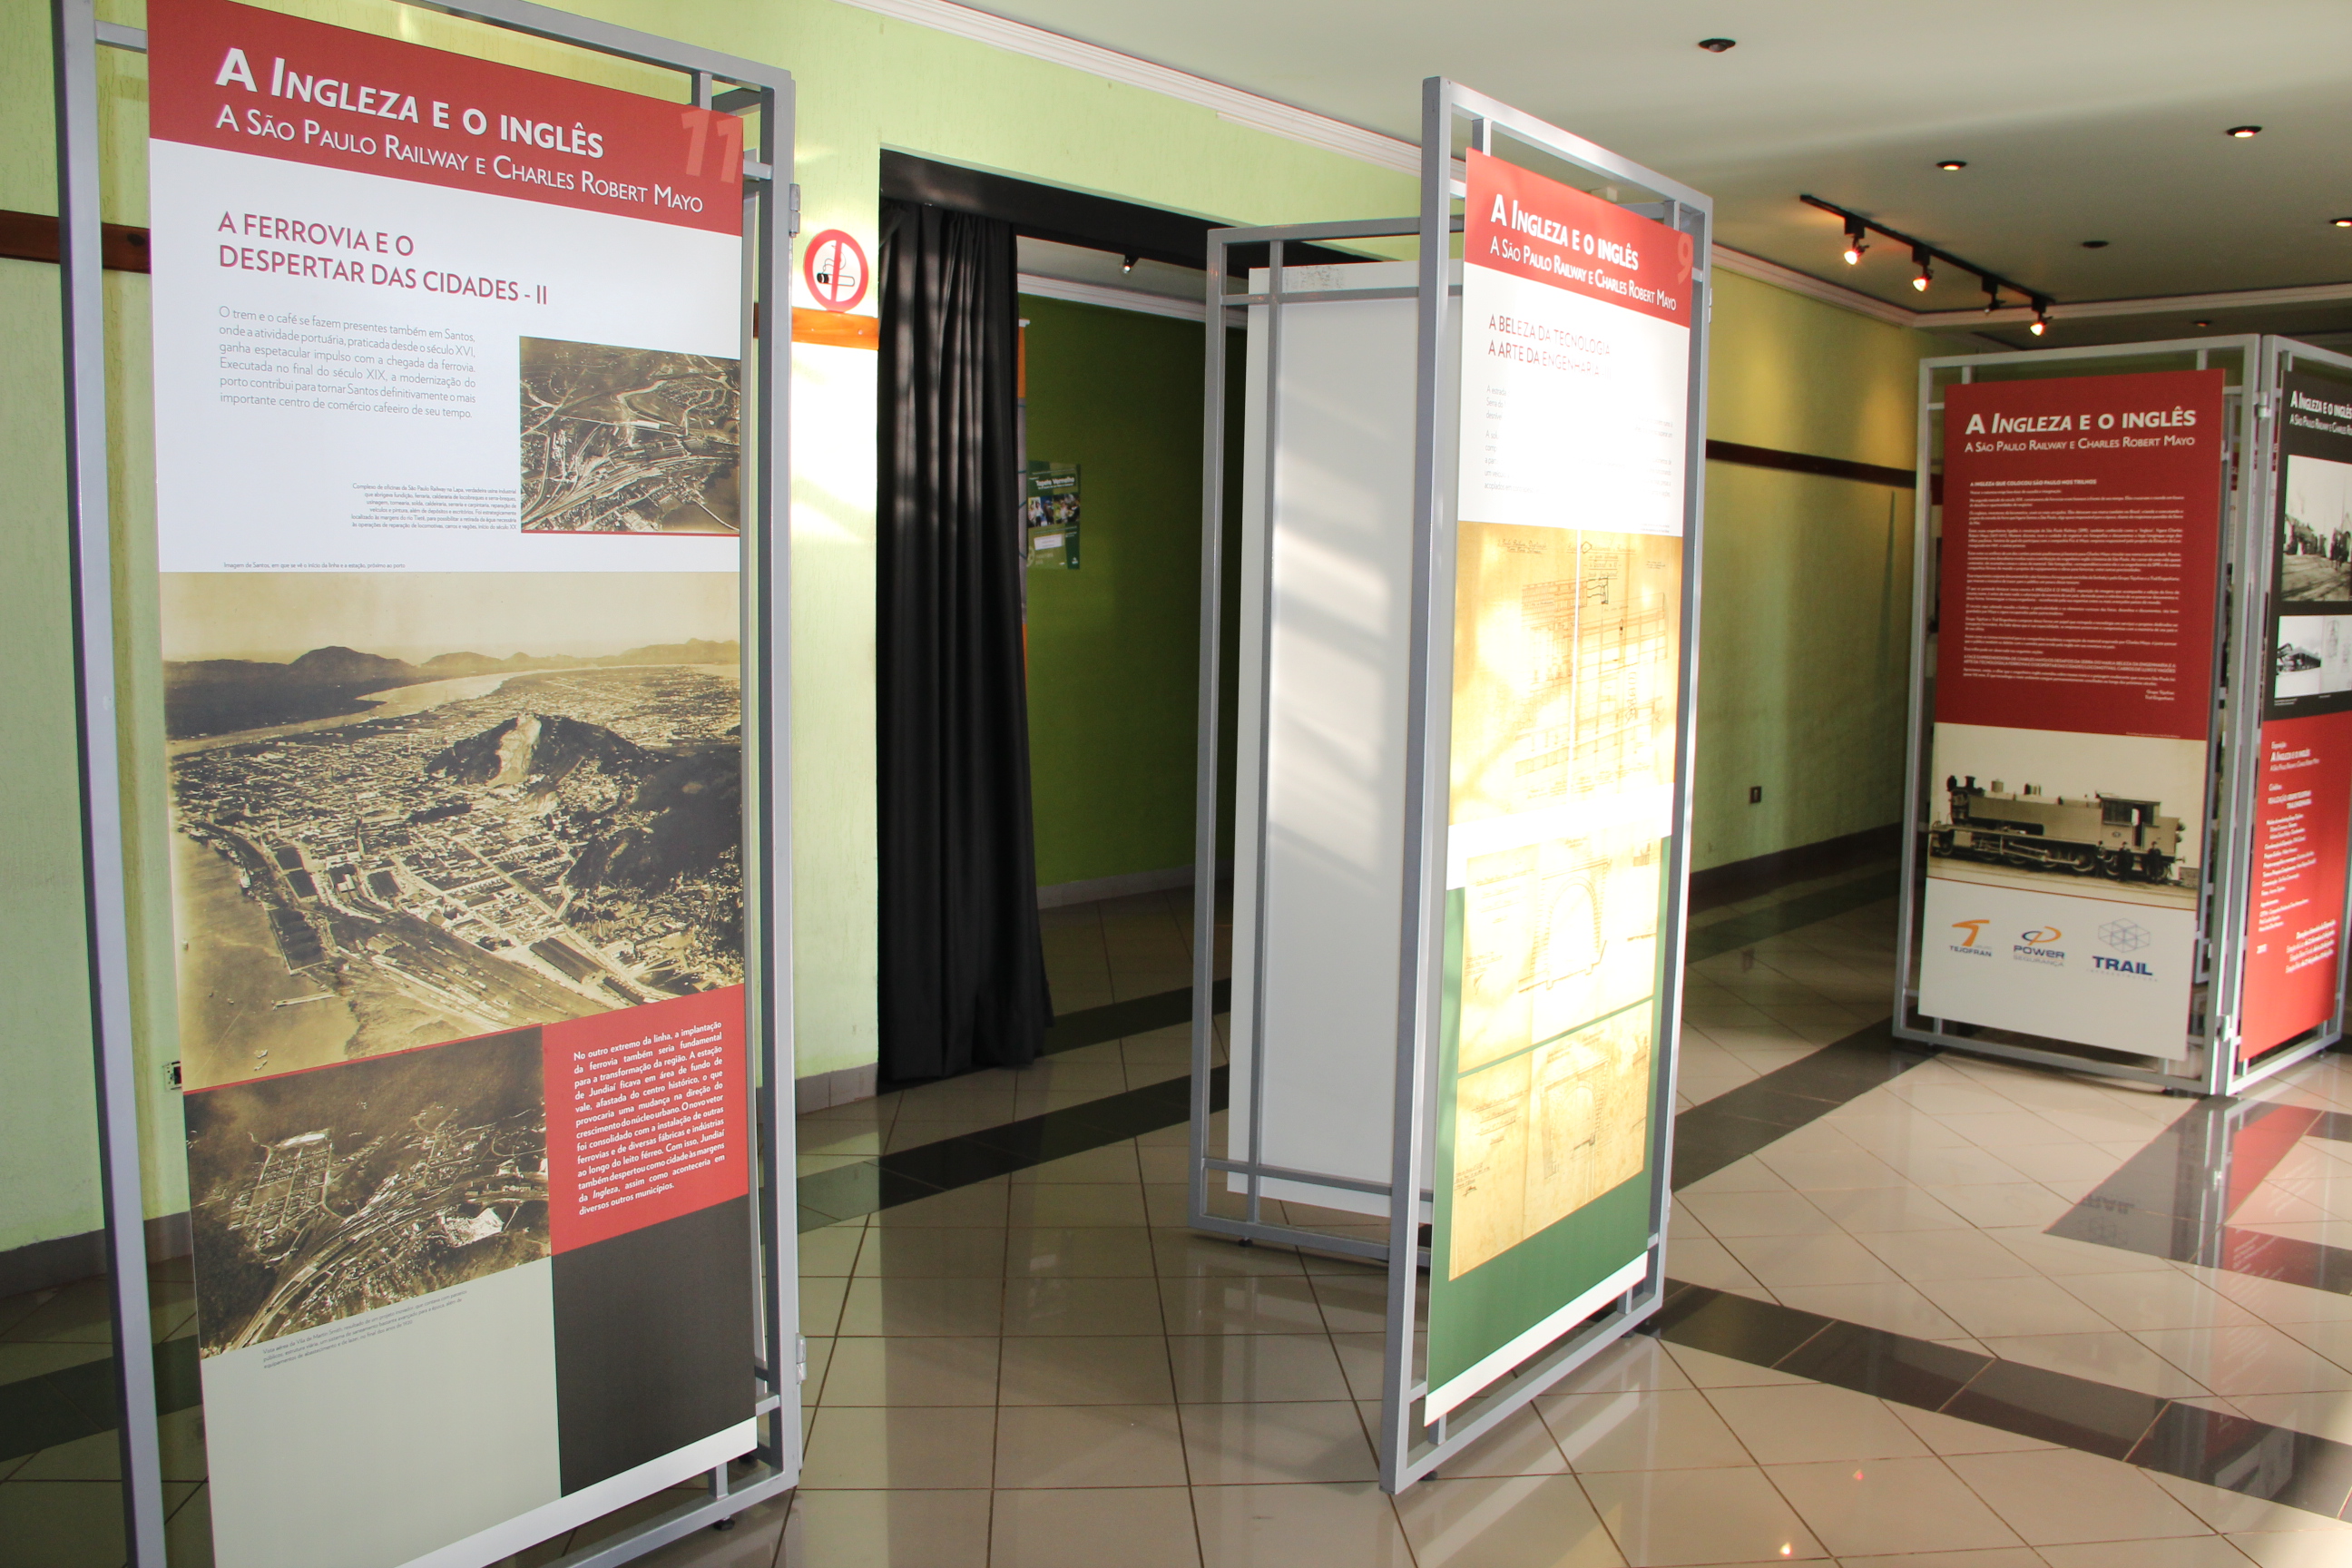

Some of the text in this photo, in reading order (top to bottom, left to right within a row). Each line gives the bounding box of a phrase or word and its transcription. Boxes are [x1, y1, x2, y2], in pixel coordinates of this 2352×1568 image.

[215, 48, 603, 158] A INGLEZA E O INGLÊS
[216, 104, 702, 212] A SÃO PAULO RAILWAY E CHARLES ROBERT MAYO
[681, 109, 742, 184] 11
[218, 211, 414, 256] A FERROVIA E O
[1490, 193, 1639, 270] A INGLEZA E O INGLÊS
[220, 245, 365, 283] DESPERTAR
[372, 264, 416, 289] DAS
[423, 270, 518, 301] CIDADES
[537, 285, 546, 304] II
[1490, 236, 1676, 310] A SÃO PAULO RAILWAY E CHARLES ROBERT MAYO
[1677, 232, 1693, 286] 9
[219, 306, 230, 318] O
[232, 310, 256, 320] trem
[259, 313, 265, 321] e
[276, 312, 297, 324] café
[299, 318, 309, 326] se
[312, 315, 340, 328] fazem
[343, 322, 387, 333] presentes
[389, 324, 426, 337] também
[445, 328, 475, 342] Santos,
[219, 326, 245, 336] onde
[254, 328, 299, 341] atividade
[301, 334, 346, 346] portuária,
[348, 338, 389, 349] praticada
[391, 339, 418, 352] desde
[426, 344, 454, 355] século
[456, 345, 475, 358] XVI,
[1488, 313, 1610, 355] A BELEZA DA TECNOLOGIA
[219, 343, 250, 354] ganha
[254, 347, 310, 358] espetacular
[314, 349, 351, 362] impulso
[354, 356, 375, 364] com
[387, 356, 425, 369] chegada
[427, 358, 438, 369] da
[441, 359, 475, 372] ferrovia.
[1965, 406, 2196, 435] A INGLEZA E O INGLÊS
[1965, 435, 2195, 452] A SÃO PAULO RAILWAY E CHARLES ROBERT MAYO
[1949, 946, 1992, 957] TEJOFRAN
[2092, 956, 2153, 976] TRAIL
[573, 1051, 585, 1061] No
[588, 1048, 608, 1057] outro
[610, 1041, 641, 1053] extremo
[642, 1036, 652, 1045] da
[653, 1032, 672, 1043] linha,
[681, 1021, 721, 1036] implantação
[573, 1032, 721, 1073] da ferrovia também seria fundamental
[574, 1078, 591, 1089] para
[600, 1063, 652, 1081] transformação
[653, 1059, 662, 1068] da
[664, 1054, 687, 1066] região.
[689, 1051, 695, 1059] A
[697, 1045, 722, 1057] estação
